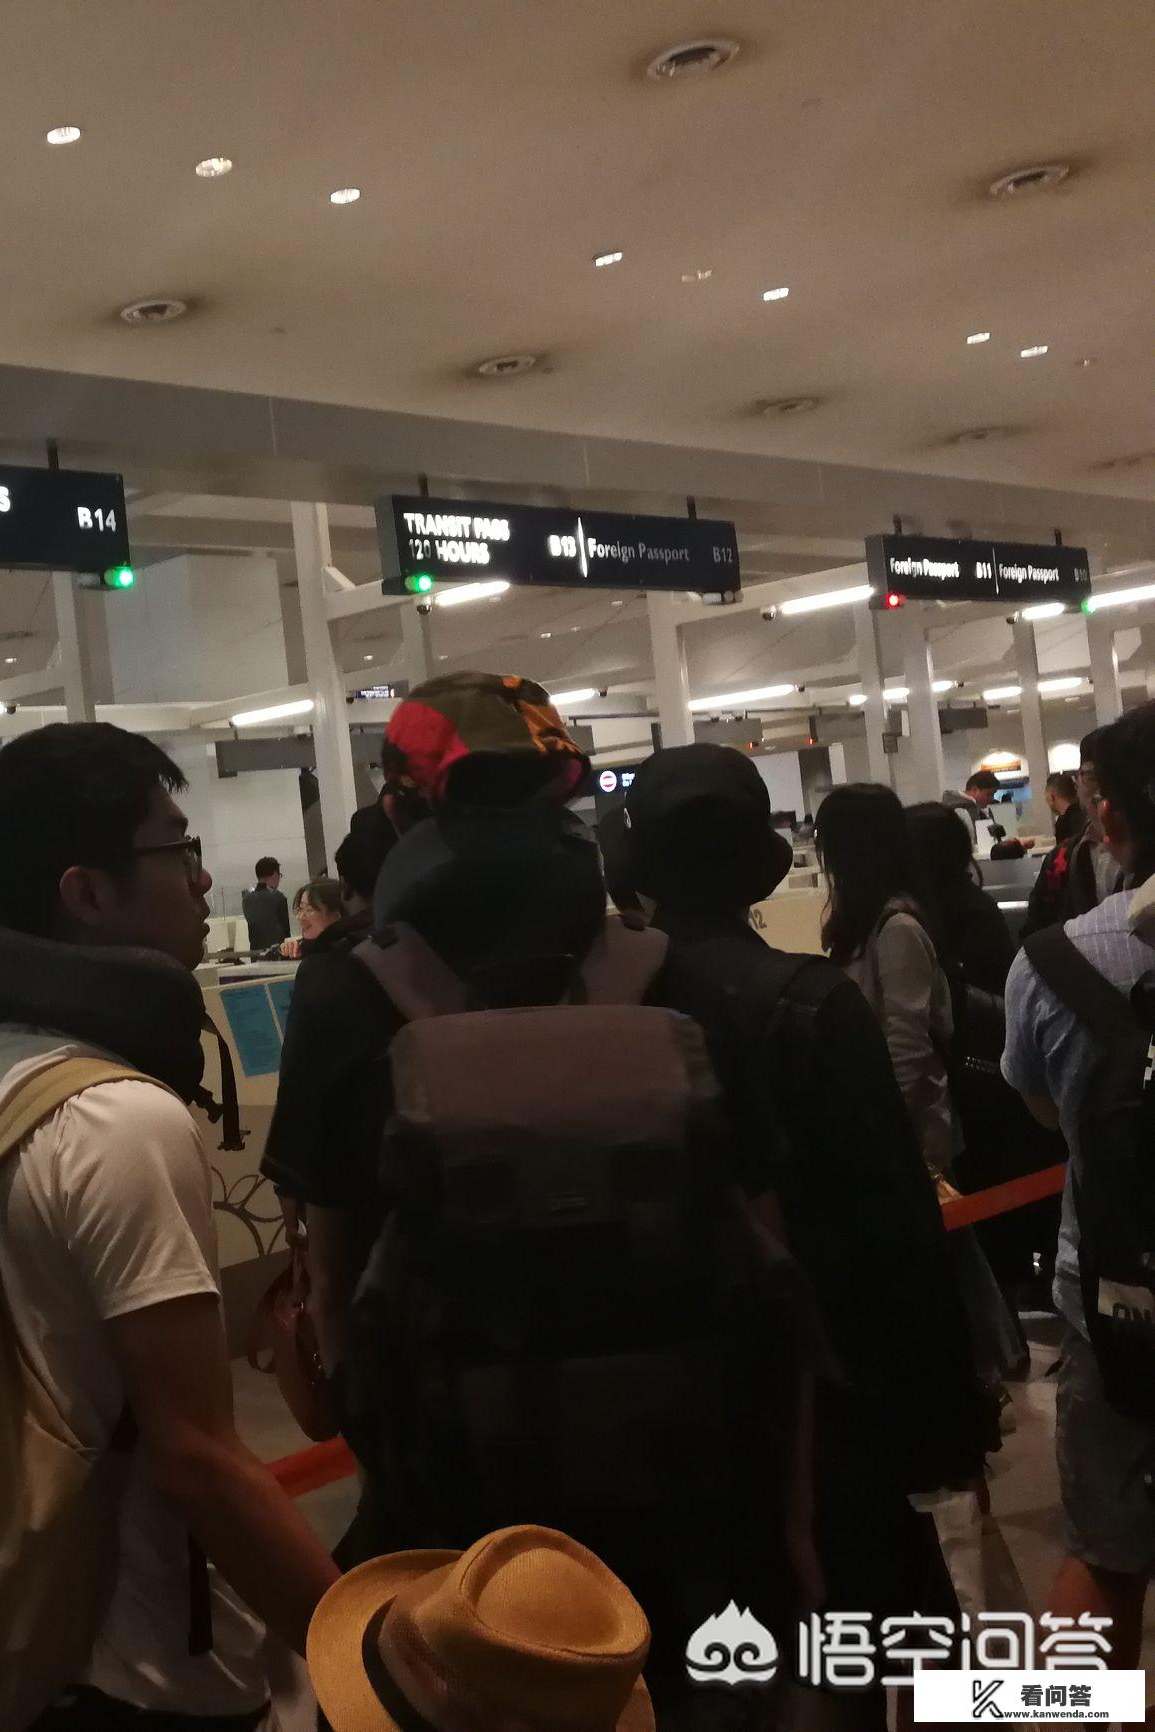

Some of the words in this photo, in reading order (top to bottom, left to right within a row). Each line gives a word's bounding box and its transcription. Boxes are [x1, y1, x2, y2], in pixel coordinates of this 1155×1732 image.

[77, 506, 117, 532] B14
[403, 512, 472, 538] TRANSIT
[473, 516, 511, 542] PASS
[409, 538, 432, 560] 120
[435, 539, 490, 565] HOURS
[587, 537, 636, 563] Foreign
[638, 541, 690, 564] Passport
[712, 546, 733, 564] B12
[976, 561, 992, 579] B11
[999, 563, 1027, 584] Foreign
[1027, 564, 1059, 584] Passport
